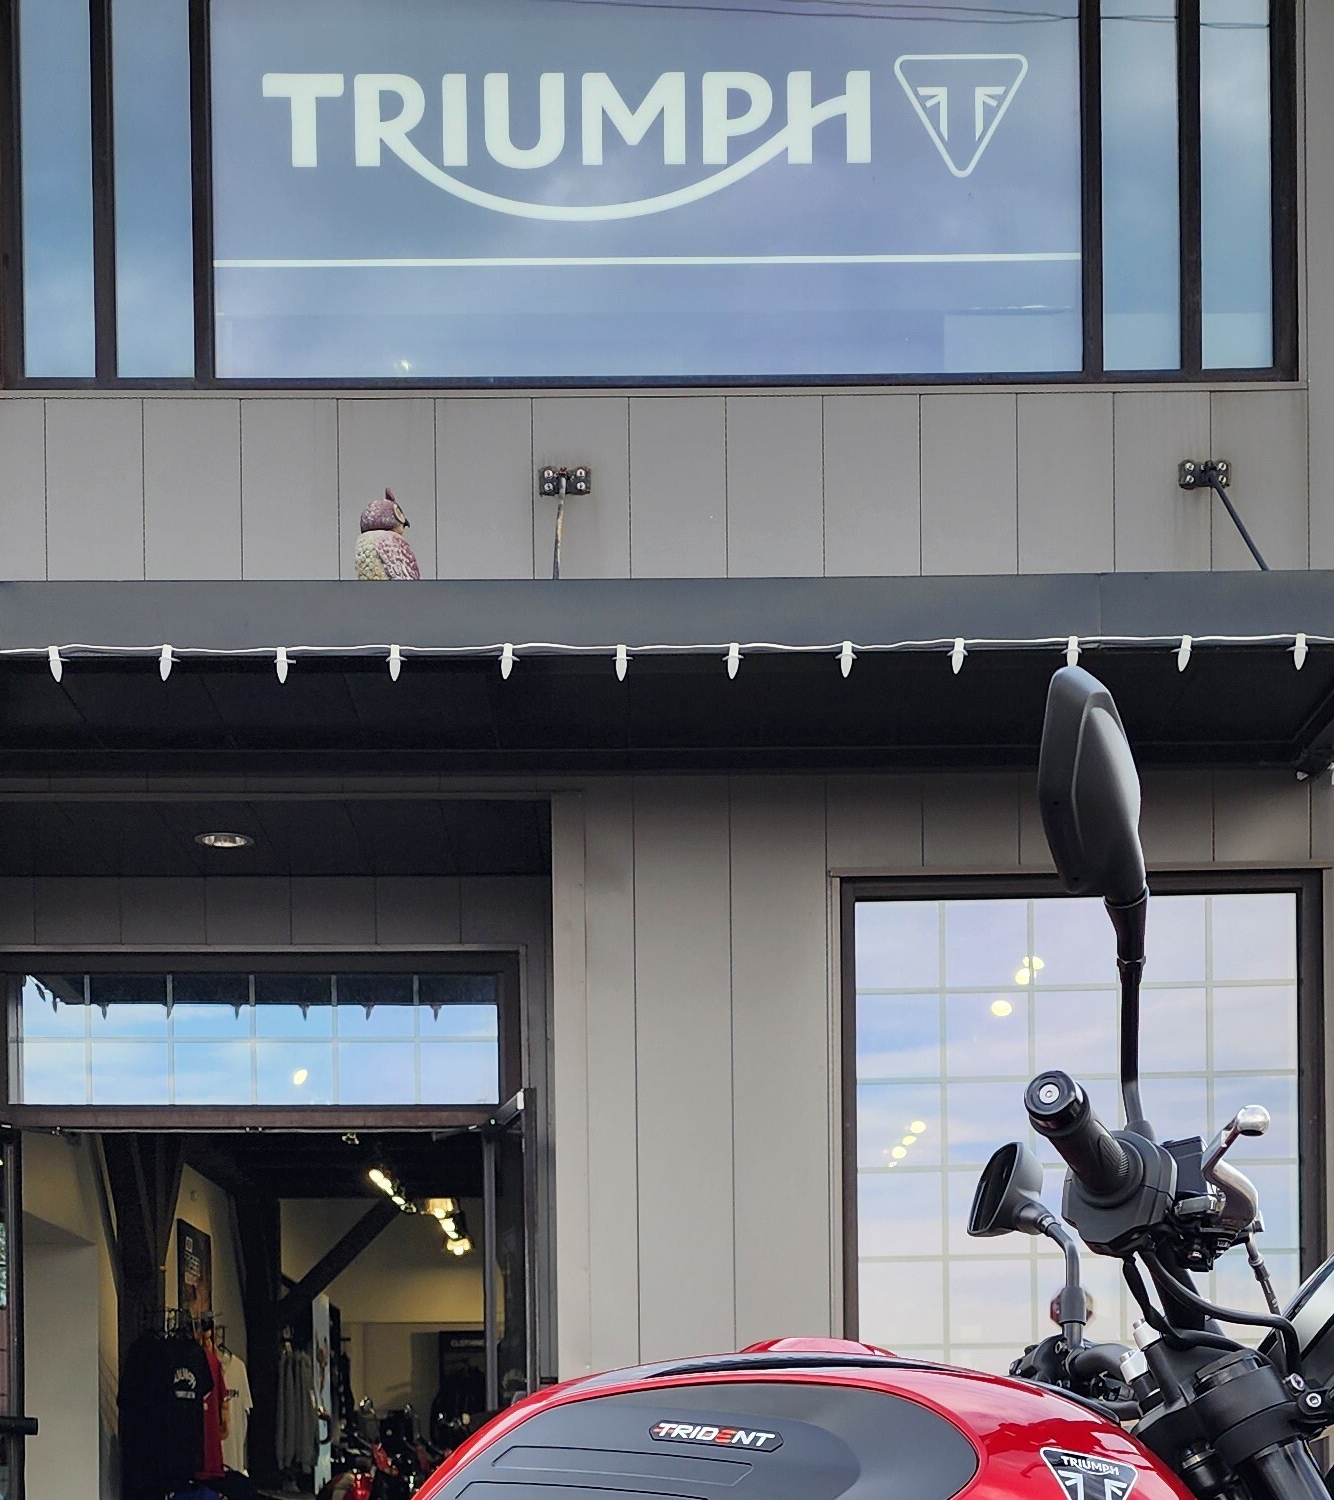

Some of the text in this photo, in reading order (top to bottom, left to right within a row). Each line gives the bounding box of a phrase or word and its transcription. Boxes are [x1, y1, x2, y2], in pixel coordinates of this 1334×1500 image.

[262, 71, 871, 221] TRIUMPH
[653, 1422, 776, 1447] TRIDENT
[1060, 1455, 1120, 1476] TRIUMPH
